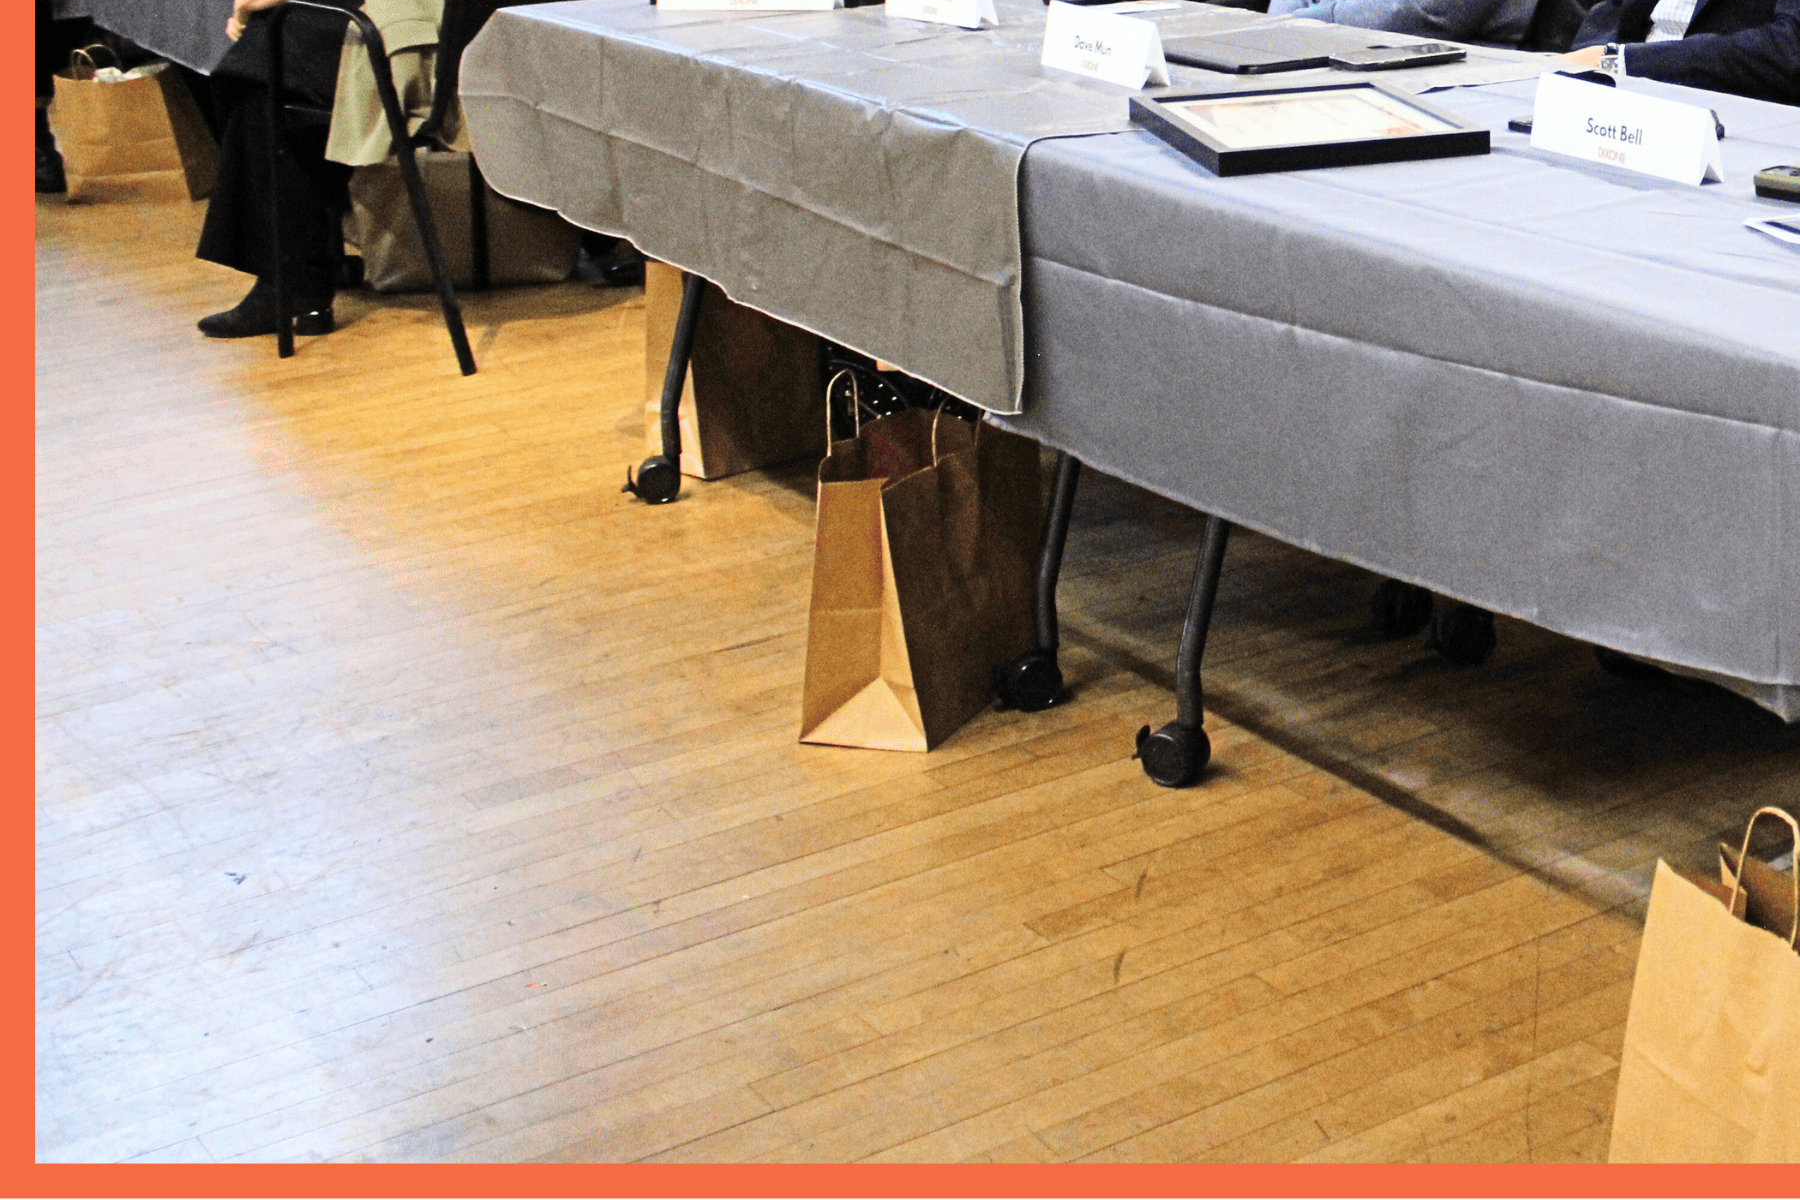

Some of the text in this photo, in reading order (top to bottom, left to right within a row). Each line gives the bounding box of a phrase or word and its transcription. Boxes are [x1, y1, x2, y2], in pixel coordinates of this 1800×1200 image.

[1074, 34, 1094, 52] Dave
[1586, 117, 1643, 146] Scott Bell
